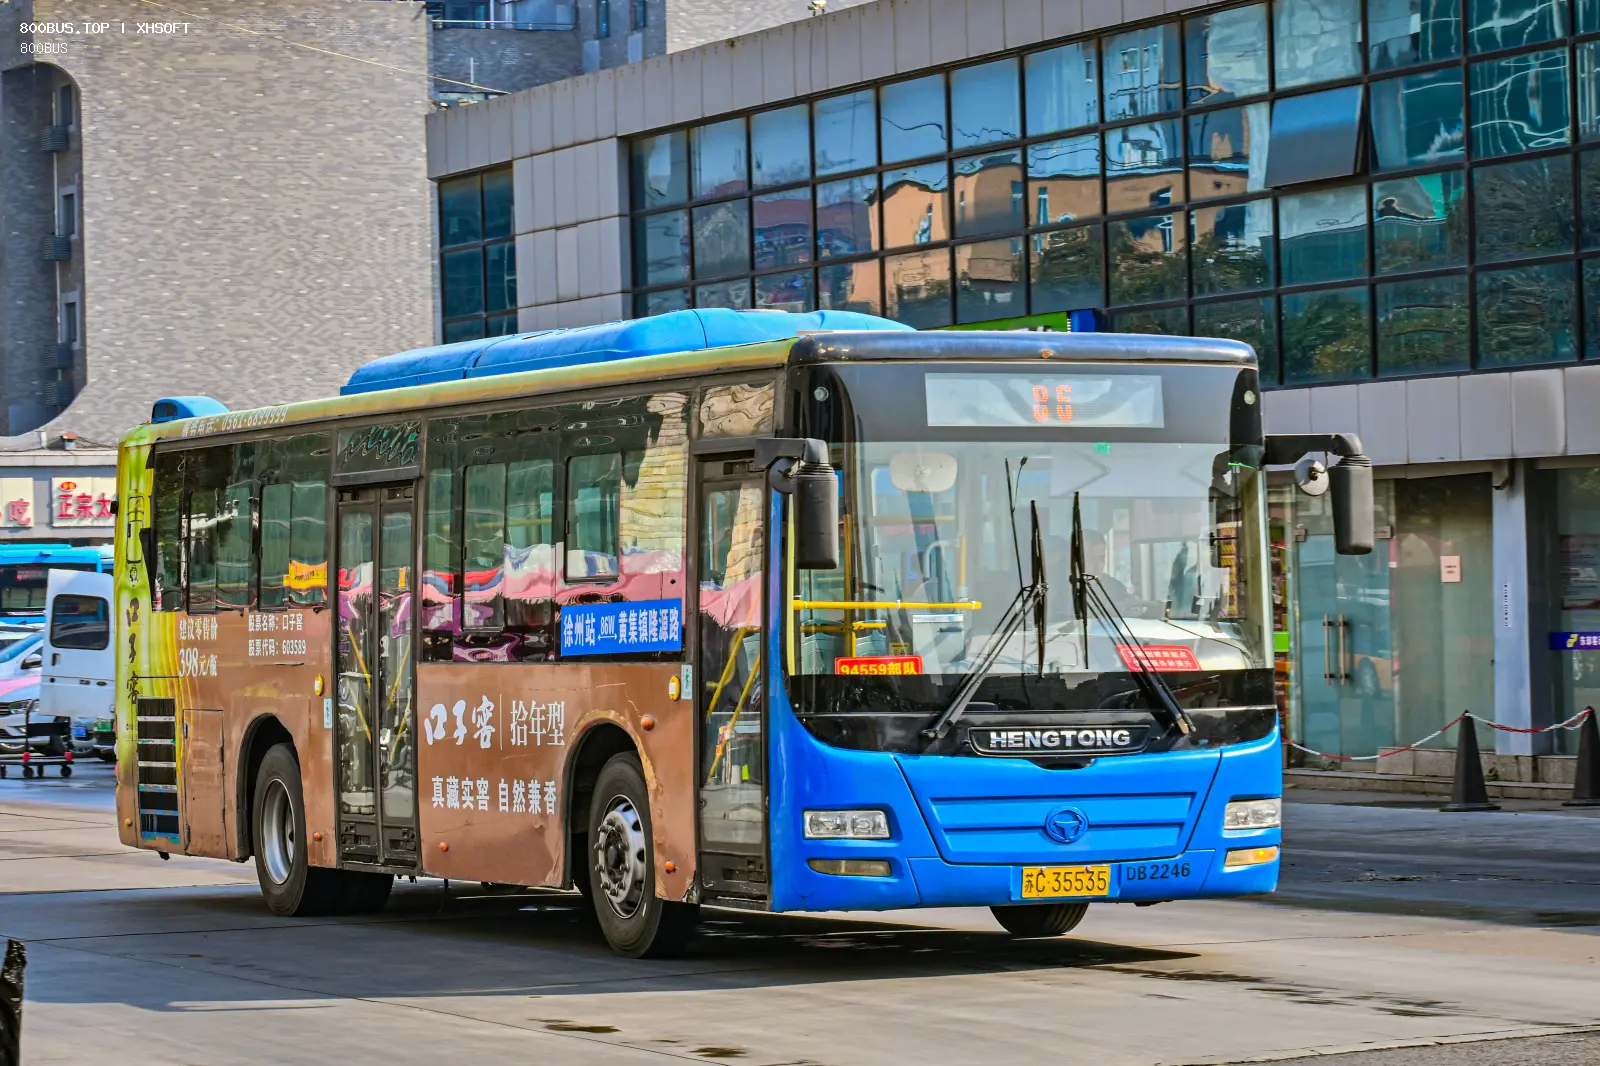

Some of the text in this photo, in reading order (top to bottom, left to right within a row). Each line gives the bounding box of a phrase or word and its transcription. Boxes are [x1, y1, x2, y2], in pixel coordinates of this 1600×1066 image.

[1032, 384, 1073, 423] 86
[0, 498, 31, 525] 吃
[179, 617, 218, 641] 建议零售价
[563, 607, 680, 648] 徐州站 86W 黄集镇隆源路
[423, 695, 566, 749] 口子窖 拾年型
[989, 729, 1131, 748] HENGTONG
[431, 776, 557, 815] 真藏实窖 自然兼香
